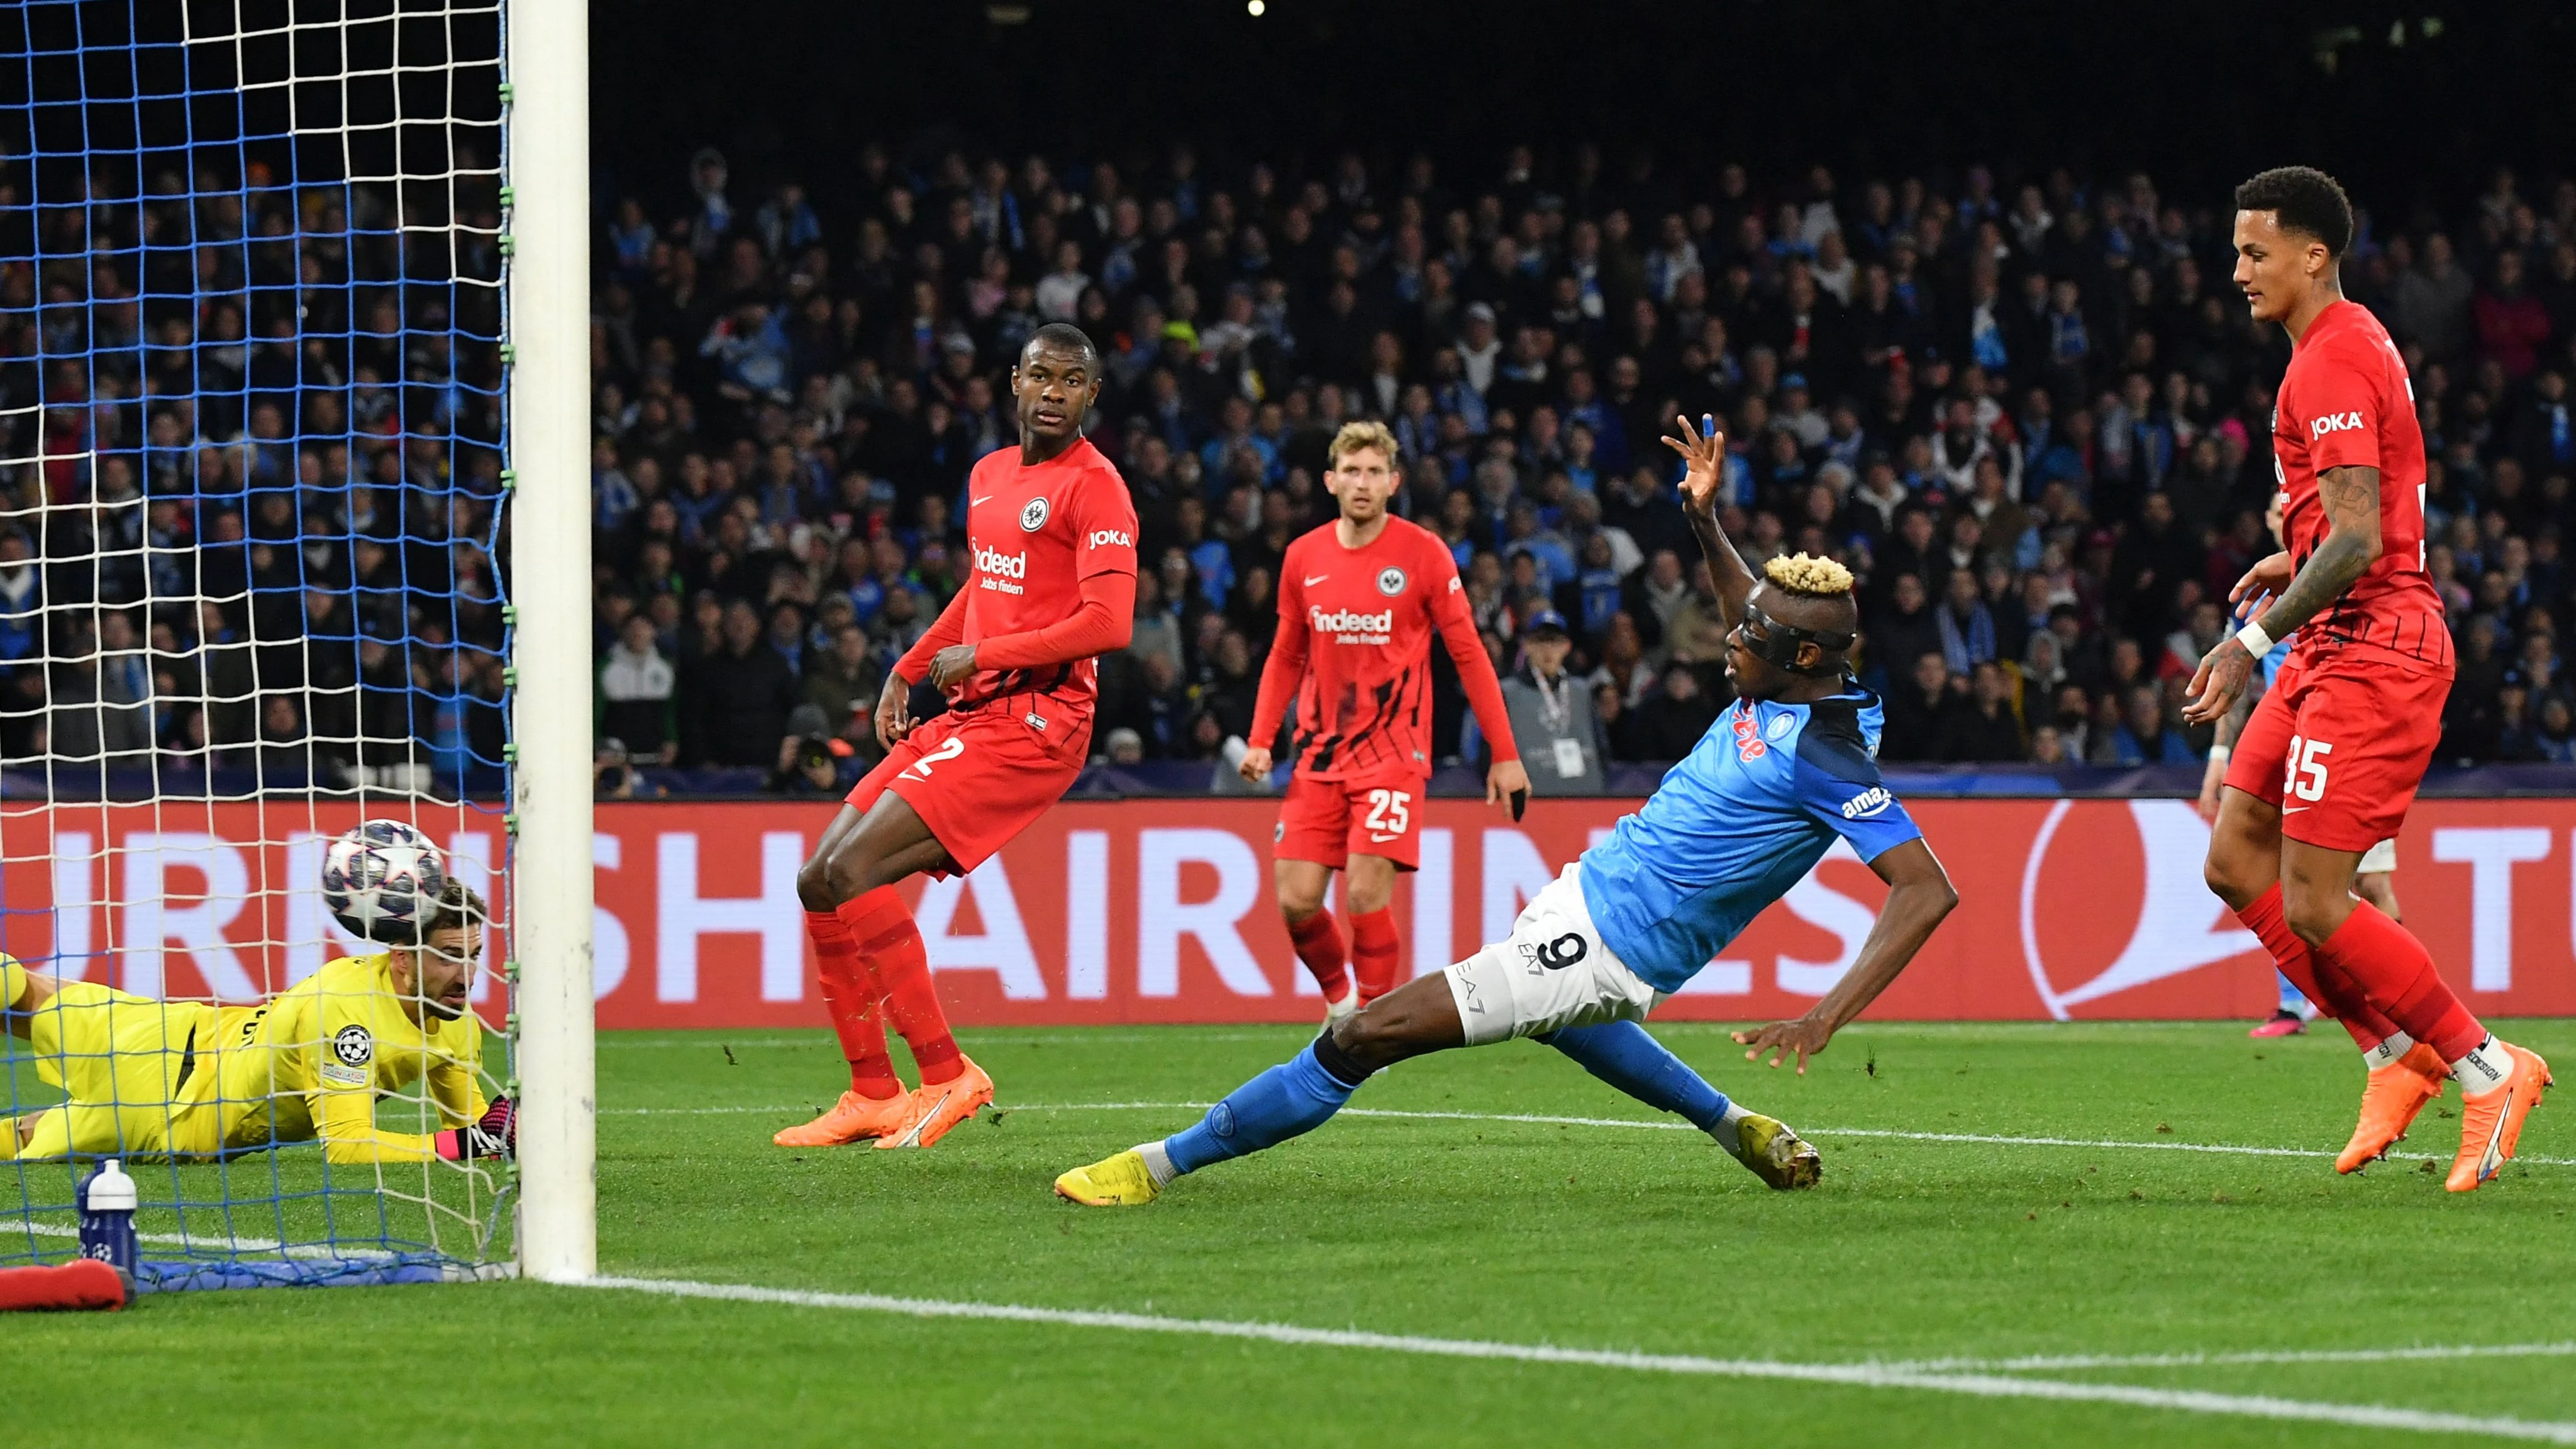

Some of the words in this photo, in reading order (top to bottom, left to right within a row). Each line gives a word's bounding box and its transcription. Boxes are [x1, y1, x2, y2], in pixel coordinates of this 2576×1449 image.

[2310, 411, 2364, 441] JOKA
[1089, 529, 1131, 551] JOKA
[980, 576, 997, 591] Jobs
[998, 579, 1023, 596] finden
[1307, 604, 1392, 633] indeed
[913, 736, 965, 777] 2
[2284, 734, 2333, 802] 35
[1364, 788, 1411, 834] 25
[912, 826, 1880, 1001] AIRIS
[2432, 826, 2576, 993] T
[1518, 943, 1545, 977] EA7
[1536, 932, 1588, 970] 9
[1455, 961, 1485, 1014] EA7
